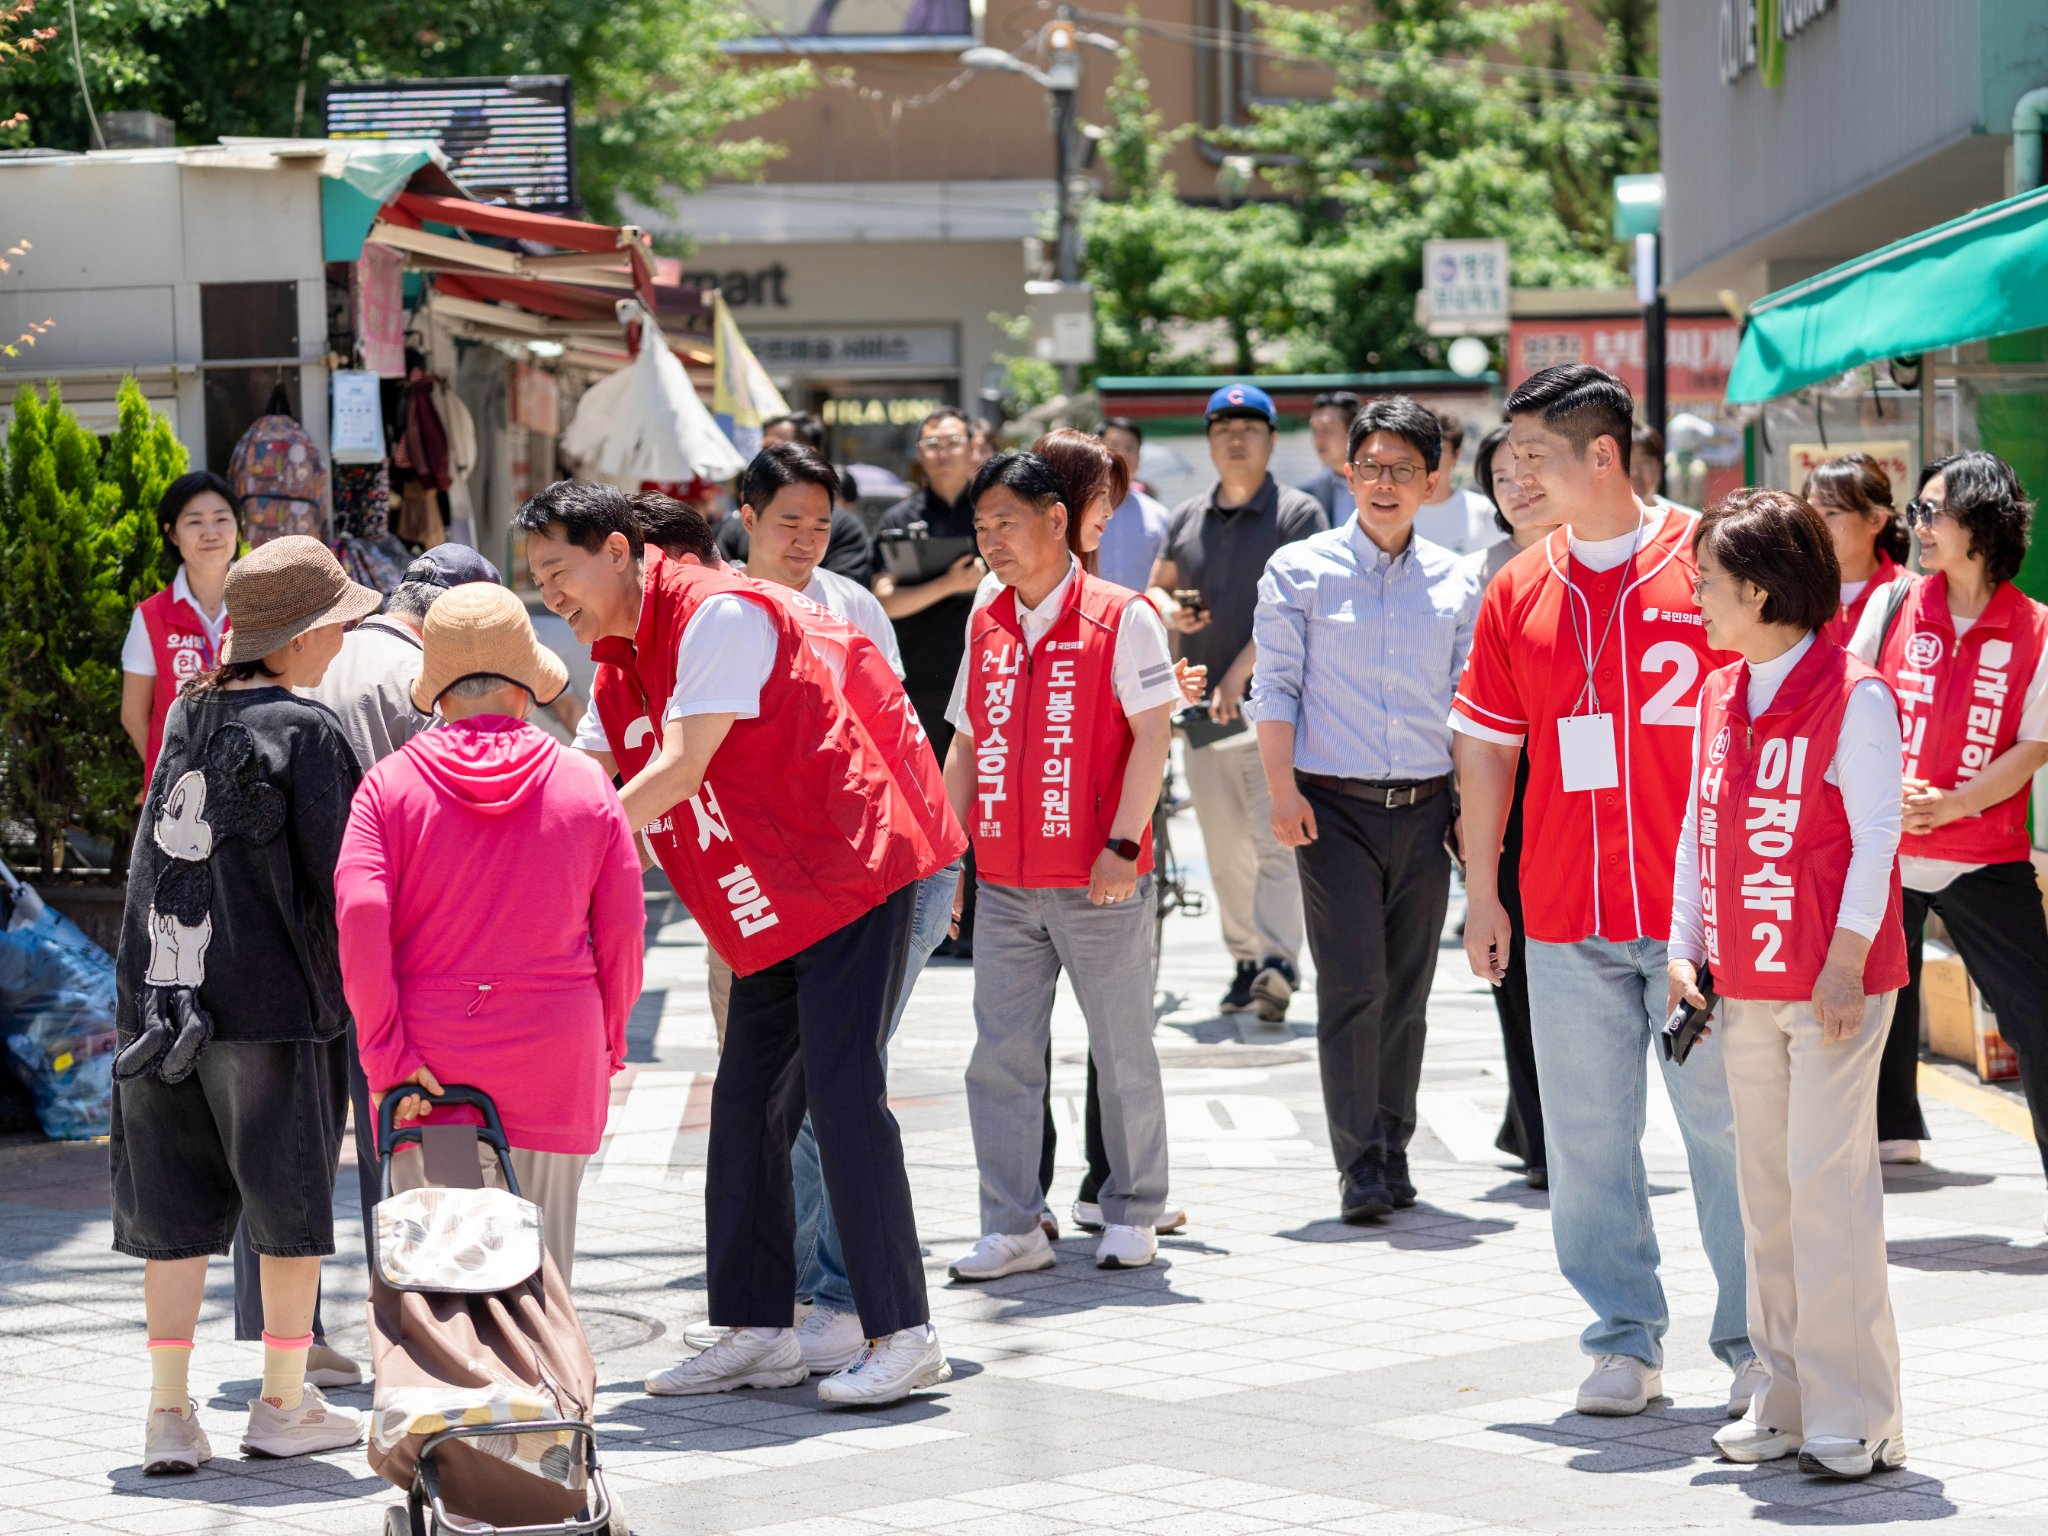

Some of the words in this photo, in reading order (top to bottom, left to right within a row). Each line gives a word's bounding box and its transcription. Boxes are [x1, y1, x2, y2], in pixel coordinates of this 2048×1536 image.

[1641, 640, 1699, 727] 2
[1661, 610, 1703, 626] 국민의힘
[977, 678, 1016, 820] 정승구
[1041, 660, 1077, 821] 도봉구의원
[1955, 668, 2008, 789] 국민의
[689, 780, 780, 939] 세훈
[1041, 822, 1071, 838] 선거
[1700, 767, 1724, 966] 서울시의원
[1741, 736, 1809, 921] 이경숙
[1751, 922, 1787, 973] 2
